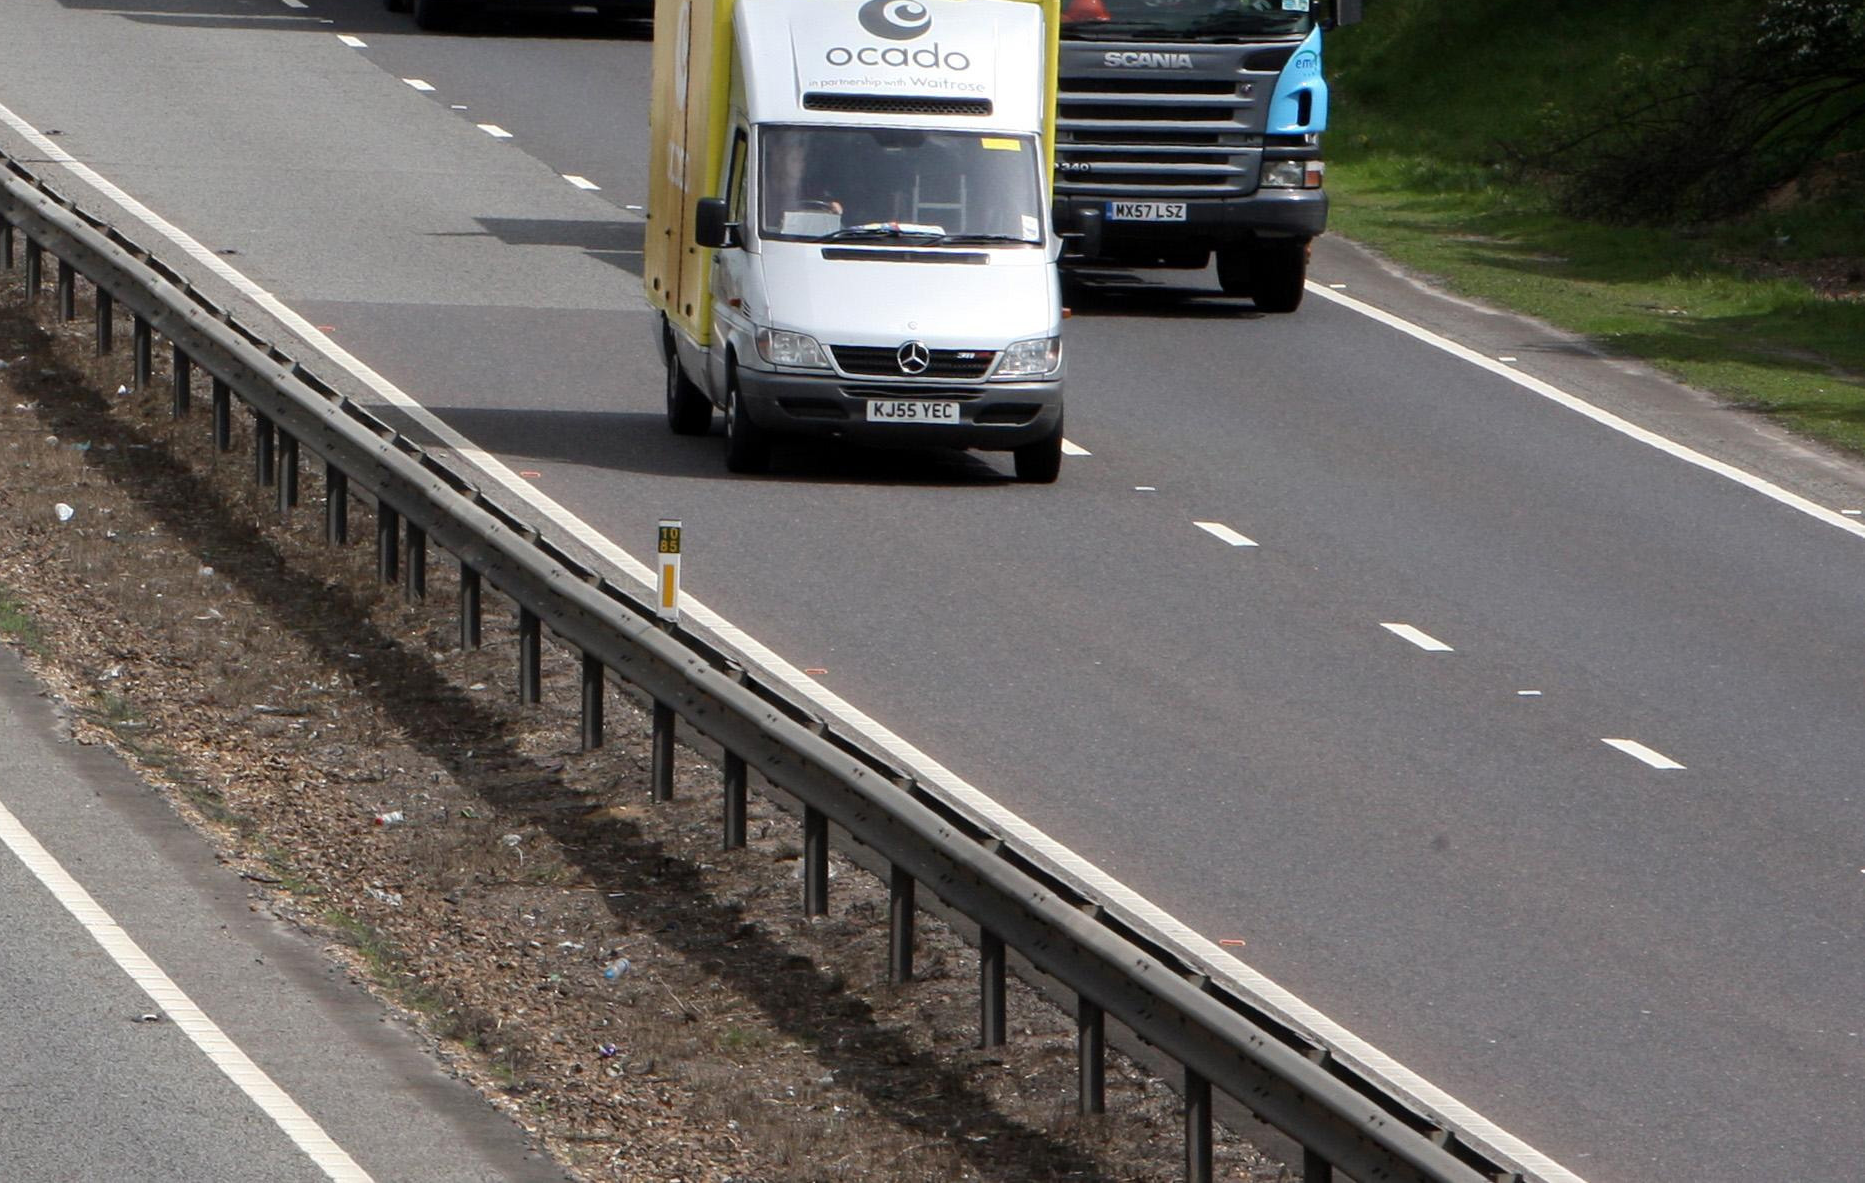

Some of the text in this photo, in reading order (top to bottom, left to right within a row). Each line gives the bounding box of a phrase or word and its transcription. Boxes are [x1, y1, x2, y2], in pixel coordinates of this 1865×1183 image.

[826, 42, 971, 71] ocado
[1104, 51, 1194, 69] SCANIA
[820, 76, 882, 88] partnership
[884, 77, 907, 87] with
[909, 75, 987, 93] Waitrose
[1115, 204, 1183, 219] MX57 LSZ
[874, 402, 952, 418] KJ55 YEC
